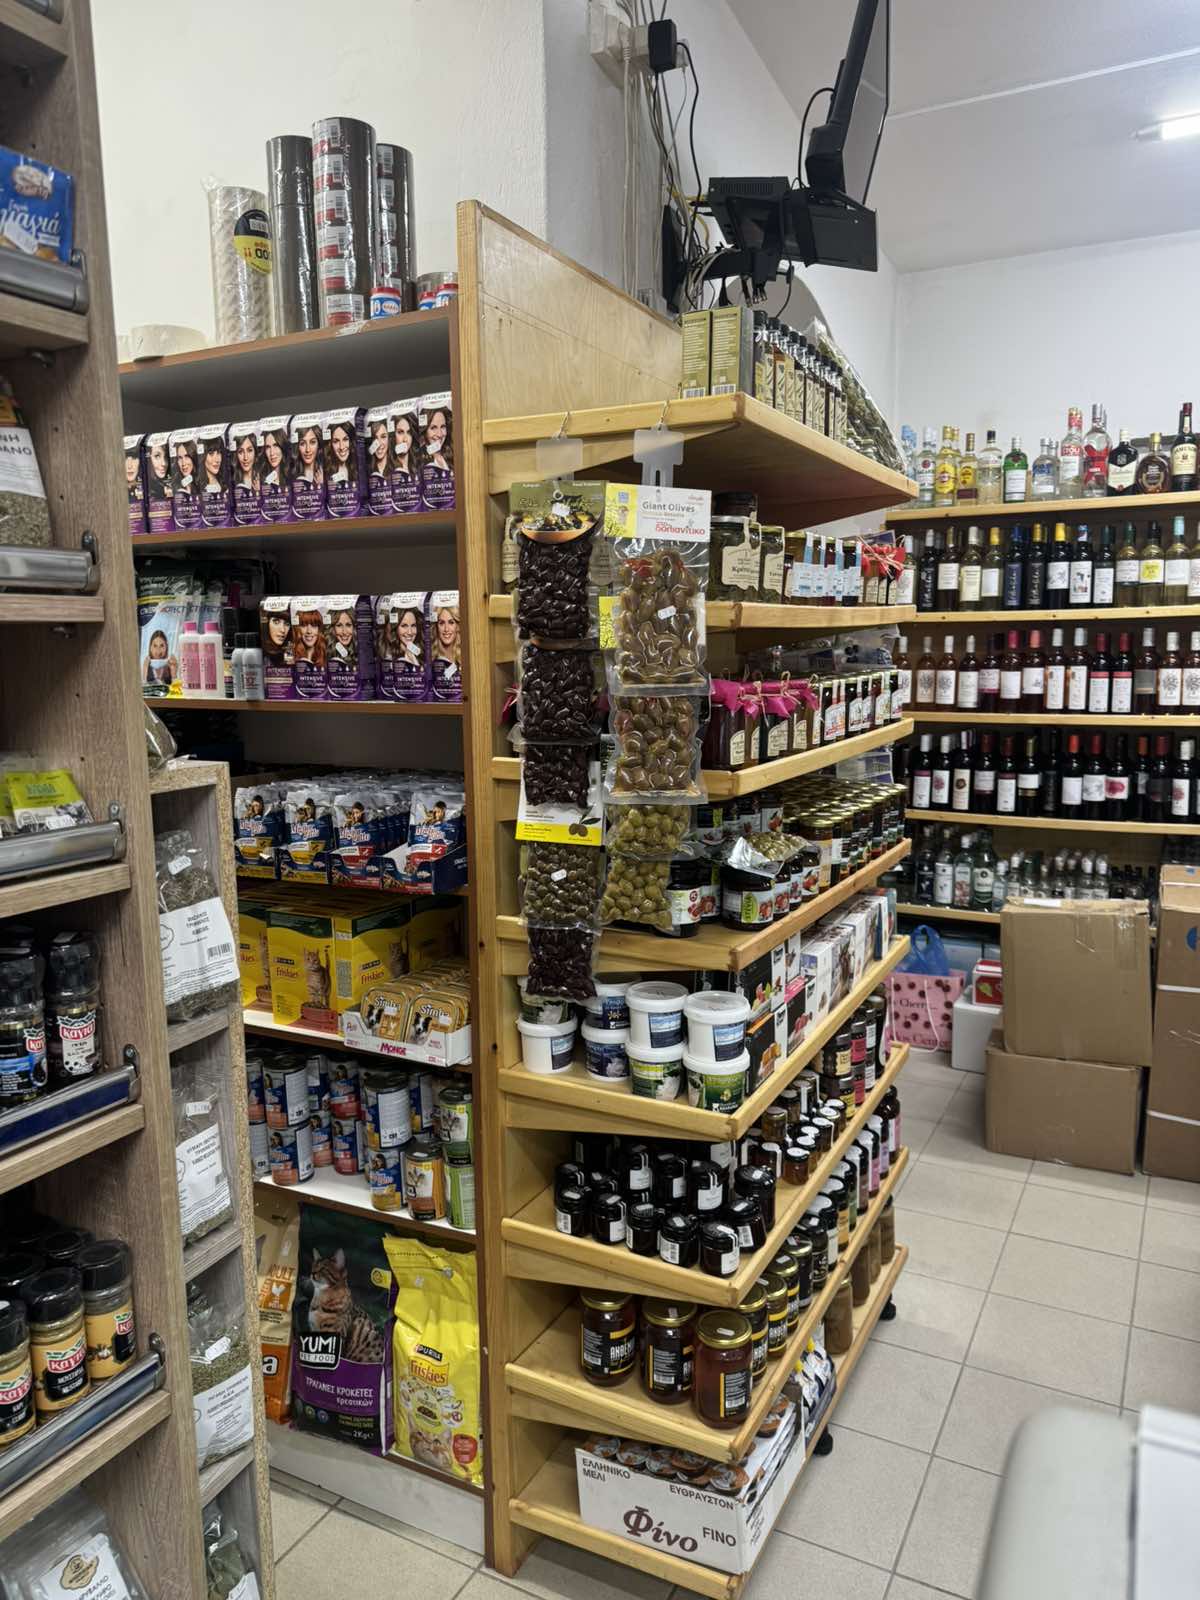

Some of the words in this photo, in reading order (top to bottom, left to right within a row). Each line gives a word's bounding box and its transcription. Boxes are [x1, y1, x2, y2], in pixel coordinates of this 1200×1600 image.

[642, 500, 667, 510] Giant
[668, 503, 695, 513] Olives
[300, 1336, 337, 1353] YUM!
[314, 1354, 336, 1362] FOOD
[337, 1387, 374, 1398] ΚΡΟΚΕΤΕΣ
[582, 1457, 631, 1480] ΕΛΛΗΝΙΚΟ
[582, 1467, 606, 1482] ΜΕΛΙ
[669, 1484, 735, 1511] ΕΥΘΡΑΥΣΤΟΝ
[623, 1505, 698, 1553] Φίνο
[702, 1526, 737, 1548] FINO
